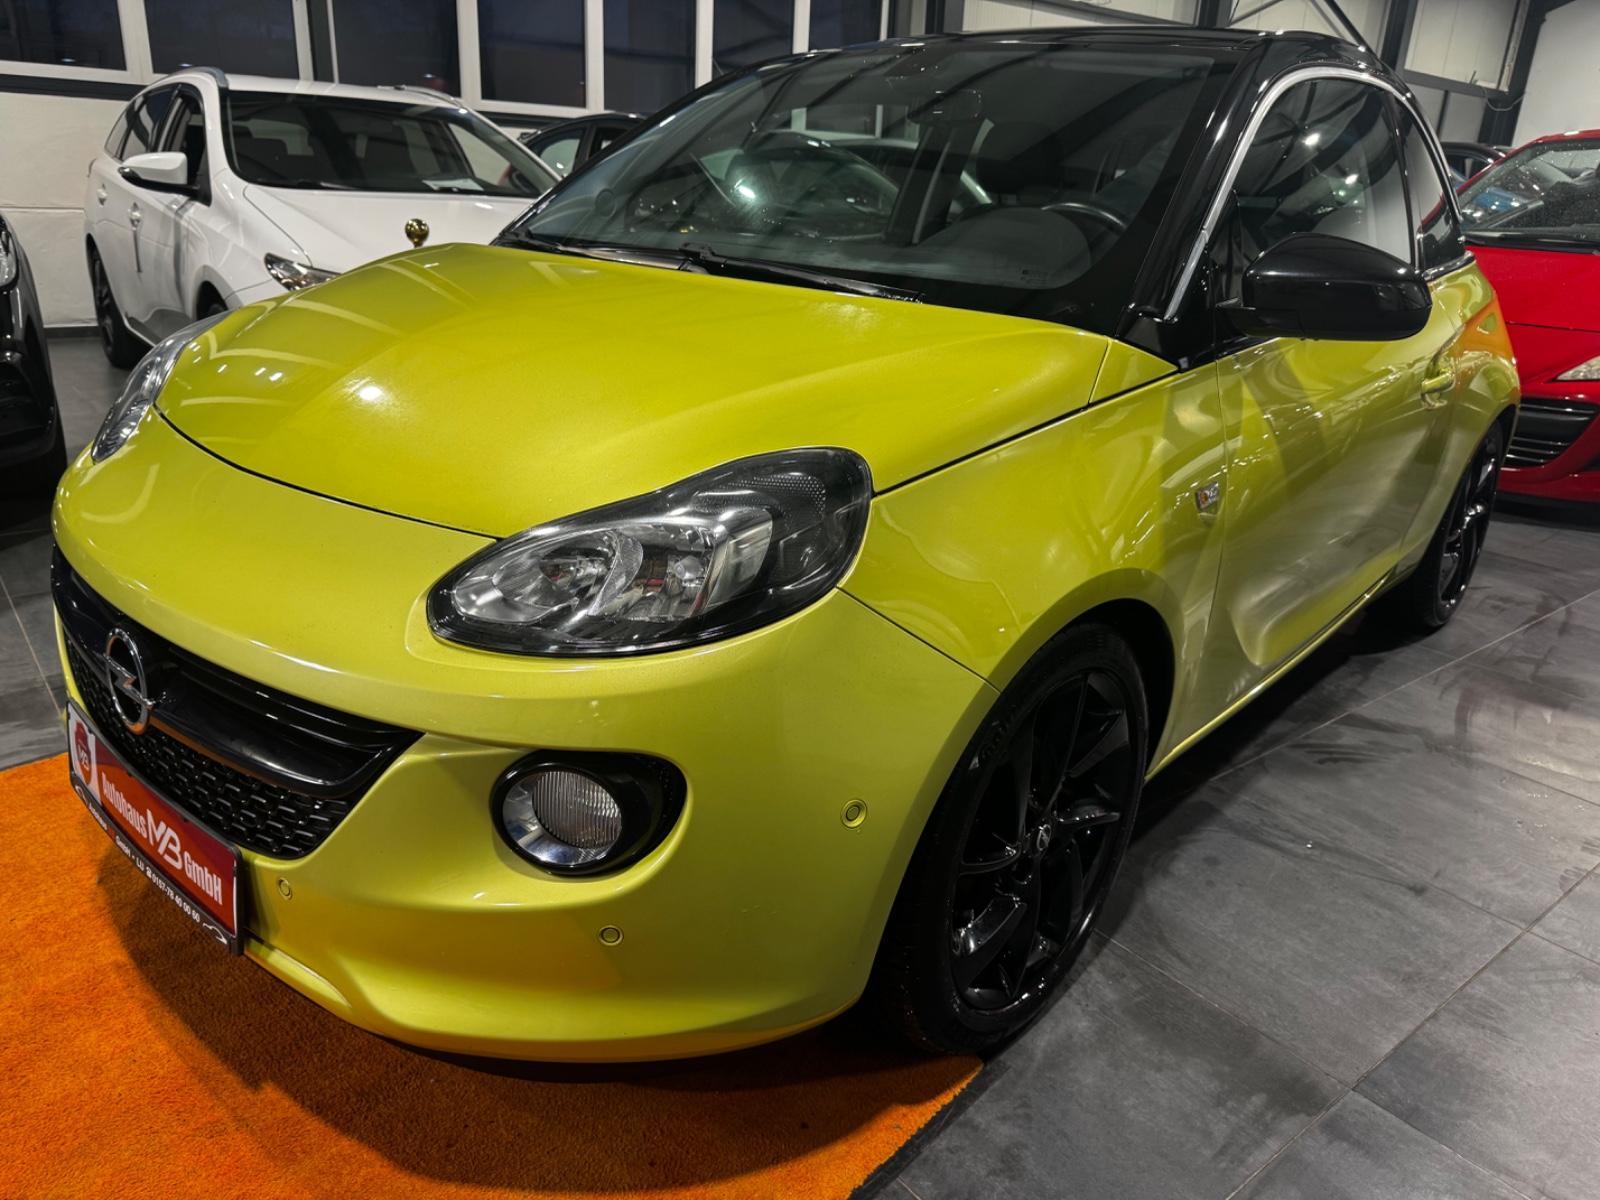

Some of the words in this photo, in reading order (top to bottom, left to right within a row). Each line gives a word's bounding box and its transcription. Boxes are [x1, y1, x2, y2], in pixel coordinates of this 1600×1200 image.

[102, 772, 148, 839] Autohaus
[146, 808, 183, 870] MB
[183, 850, 223, 906] GmbH
